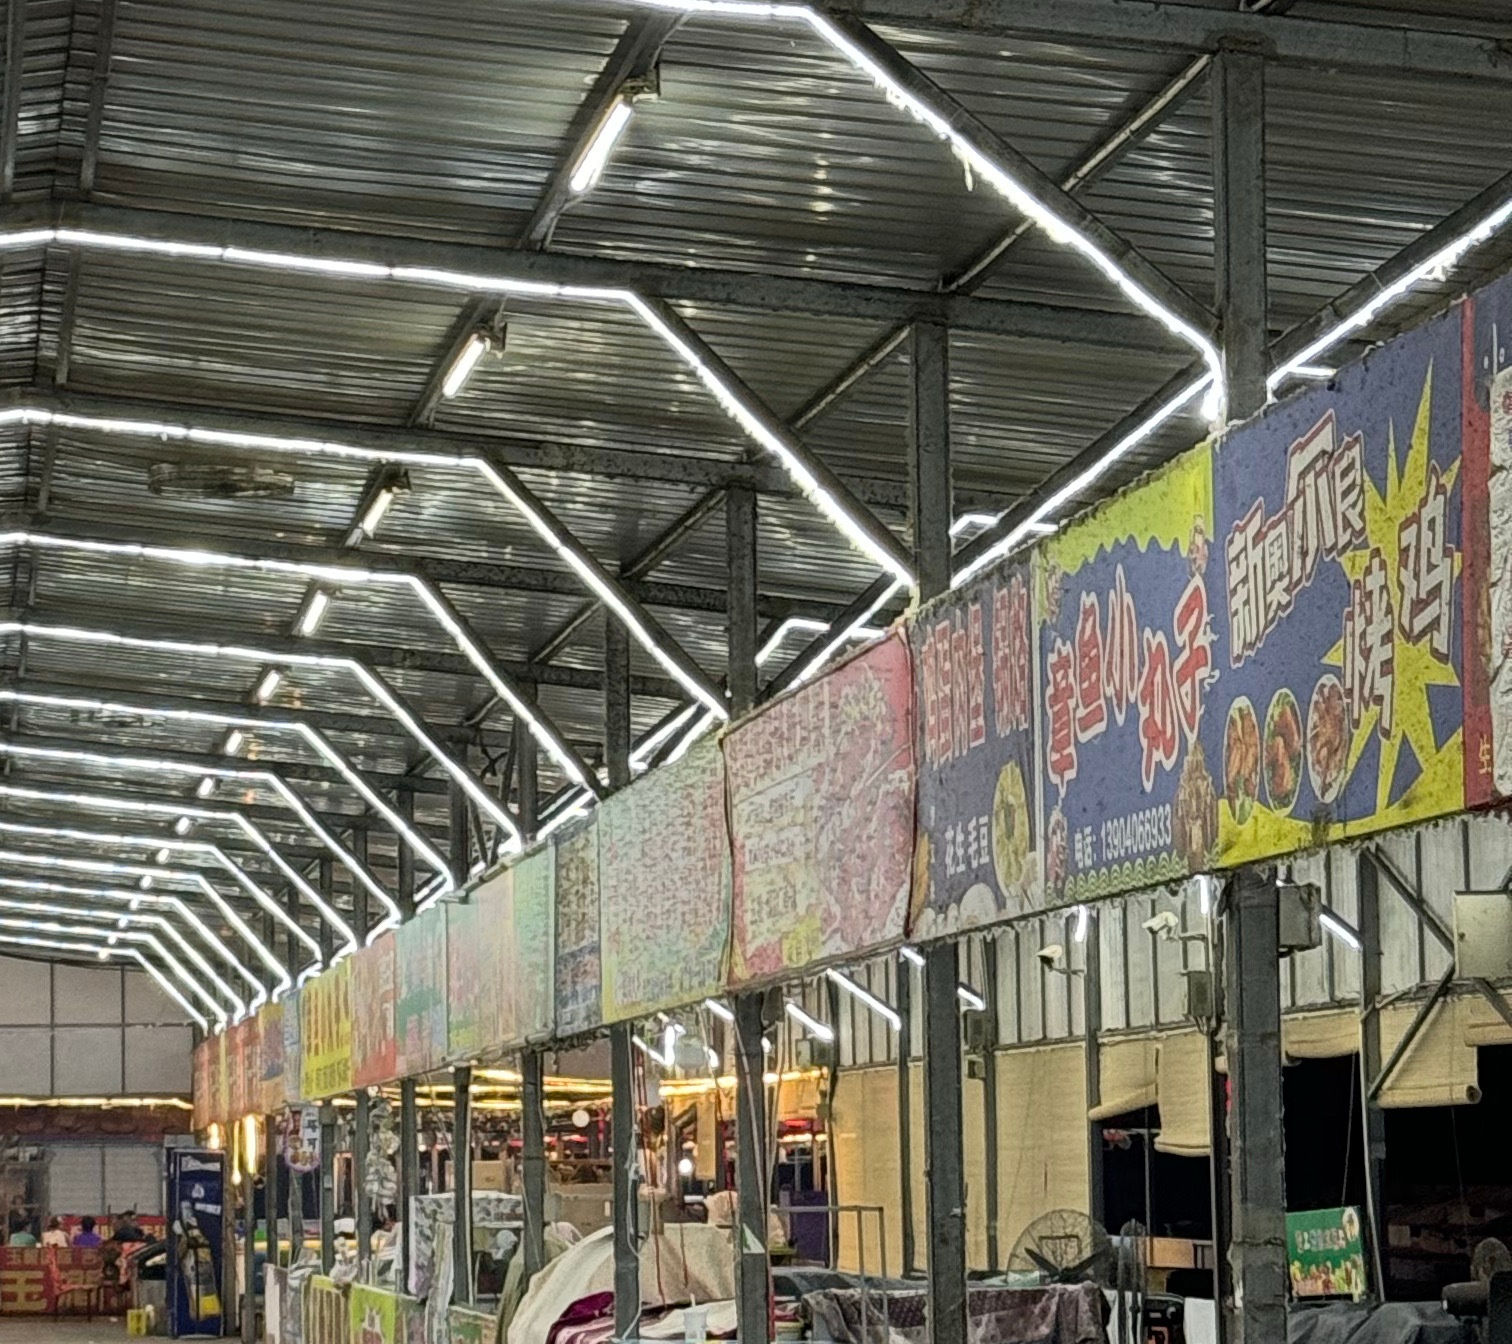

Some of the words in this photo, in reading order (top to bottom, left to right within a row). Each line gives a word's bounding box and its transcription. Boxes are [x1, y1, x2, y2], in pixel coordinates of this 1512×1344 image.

[1225, 409, 1366, 667] 新奥尔良
[1343, 461, 1455, 740] 烤鸡
[1045, 563, 1213, 793] 章鱼小丸子
